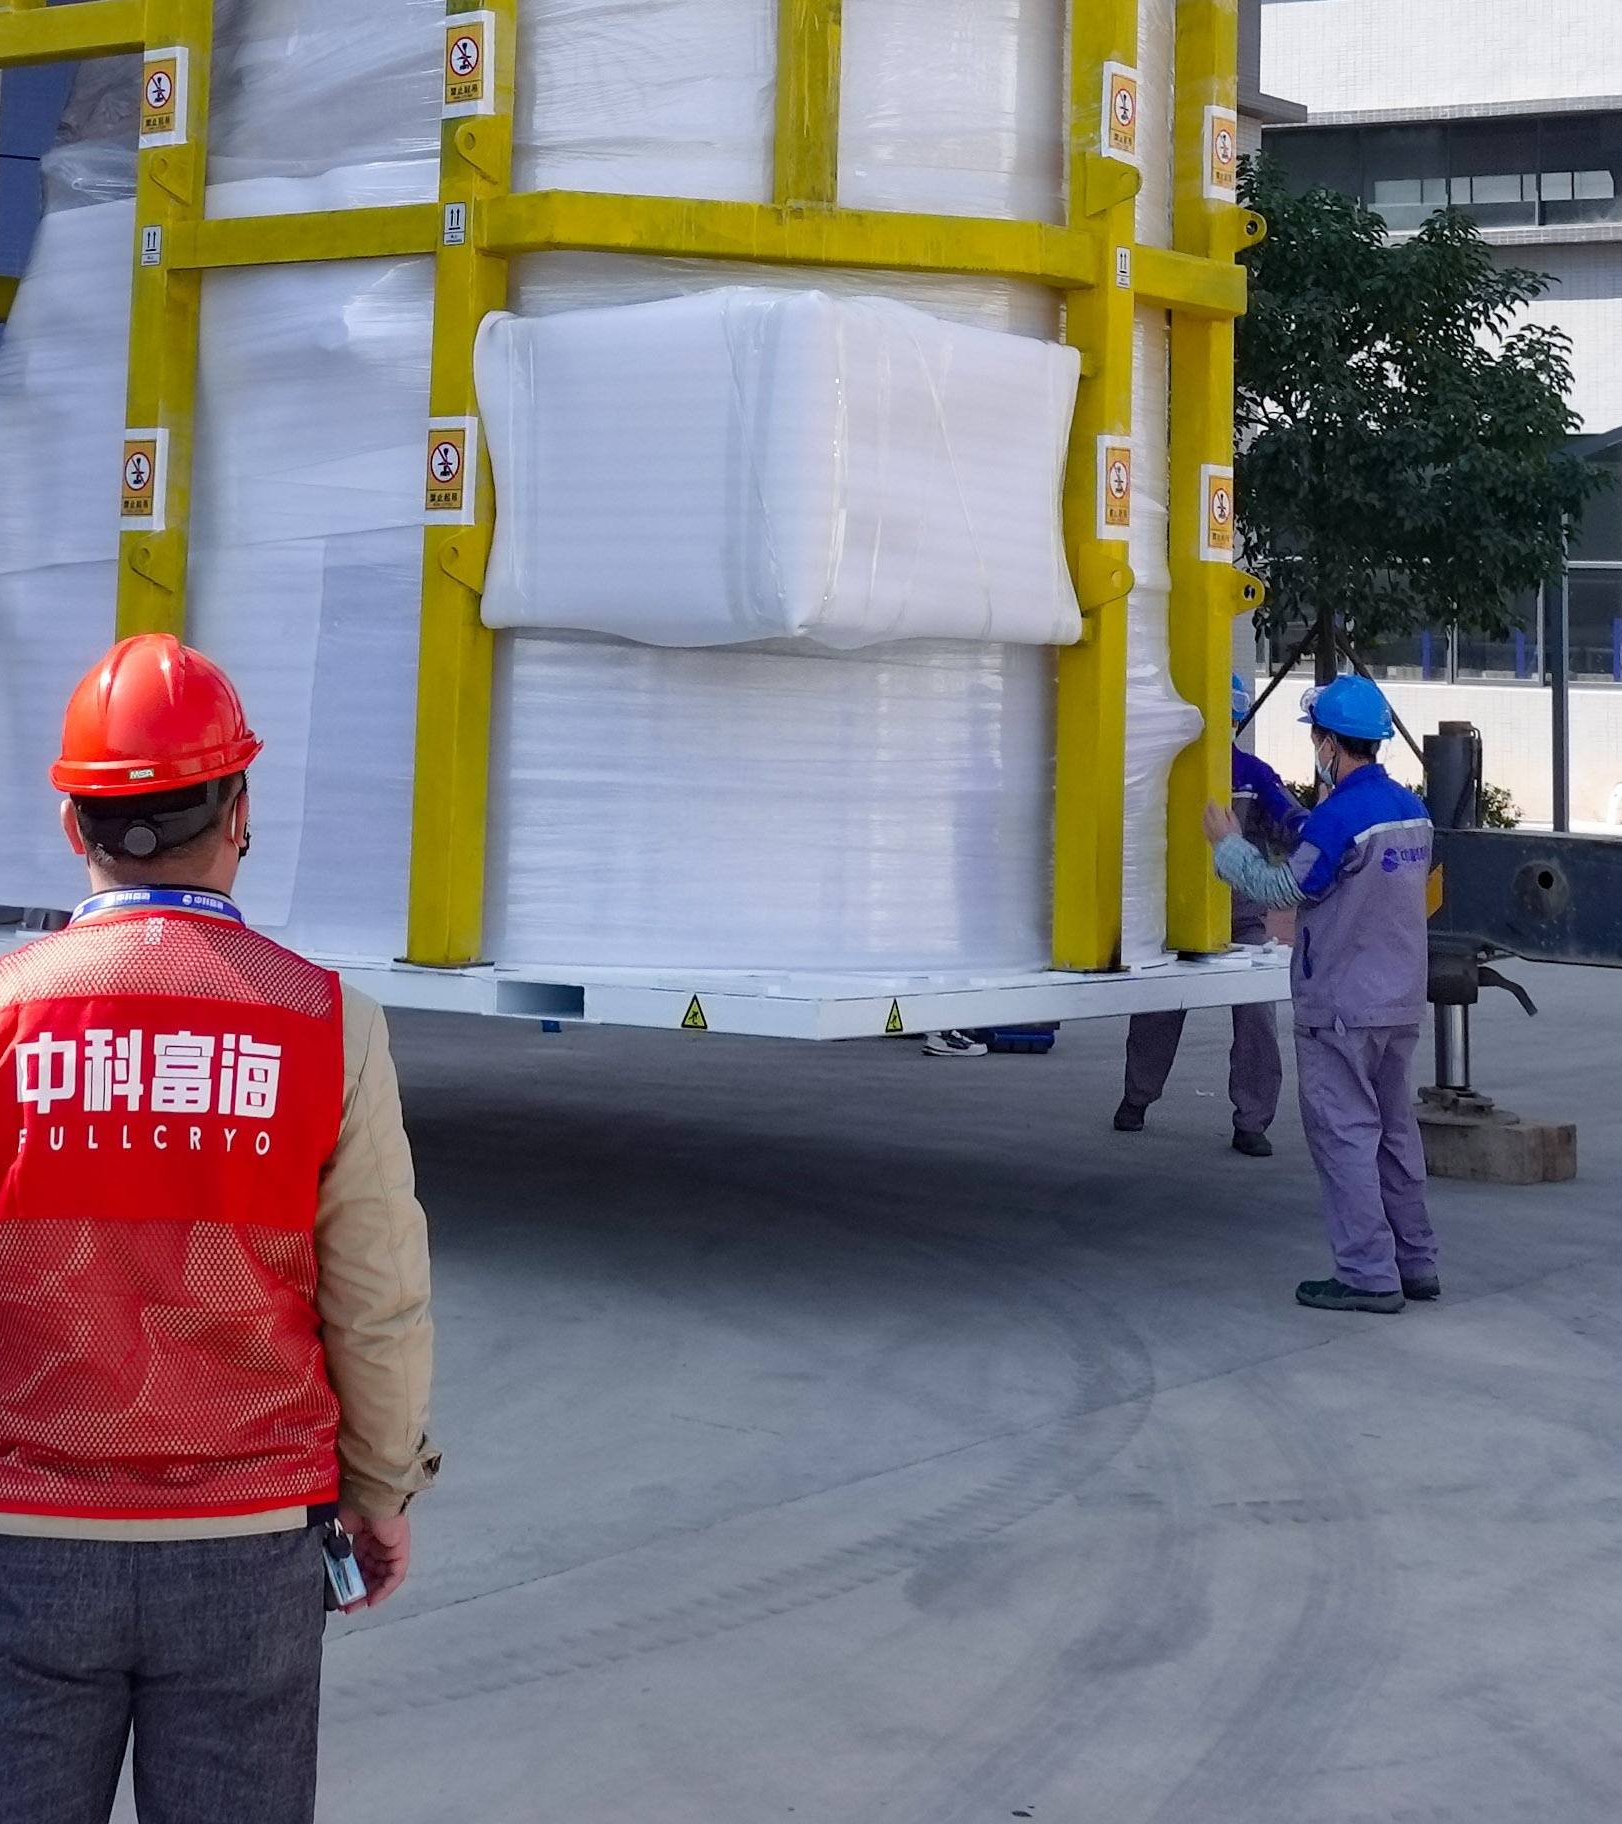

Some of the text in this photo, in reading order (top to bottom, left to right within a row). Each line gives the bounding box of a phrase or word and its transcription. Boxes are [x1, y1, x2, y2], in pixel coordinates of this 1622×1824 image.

[14, 1028, 283, 1120] 中科富海
[17, 1124, 272, 1156] FULLCRYO
